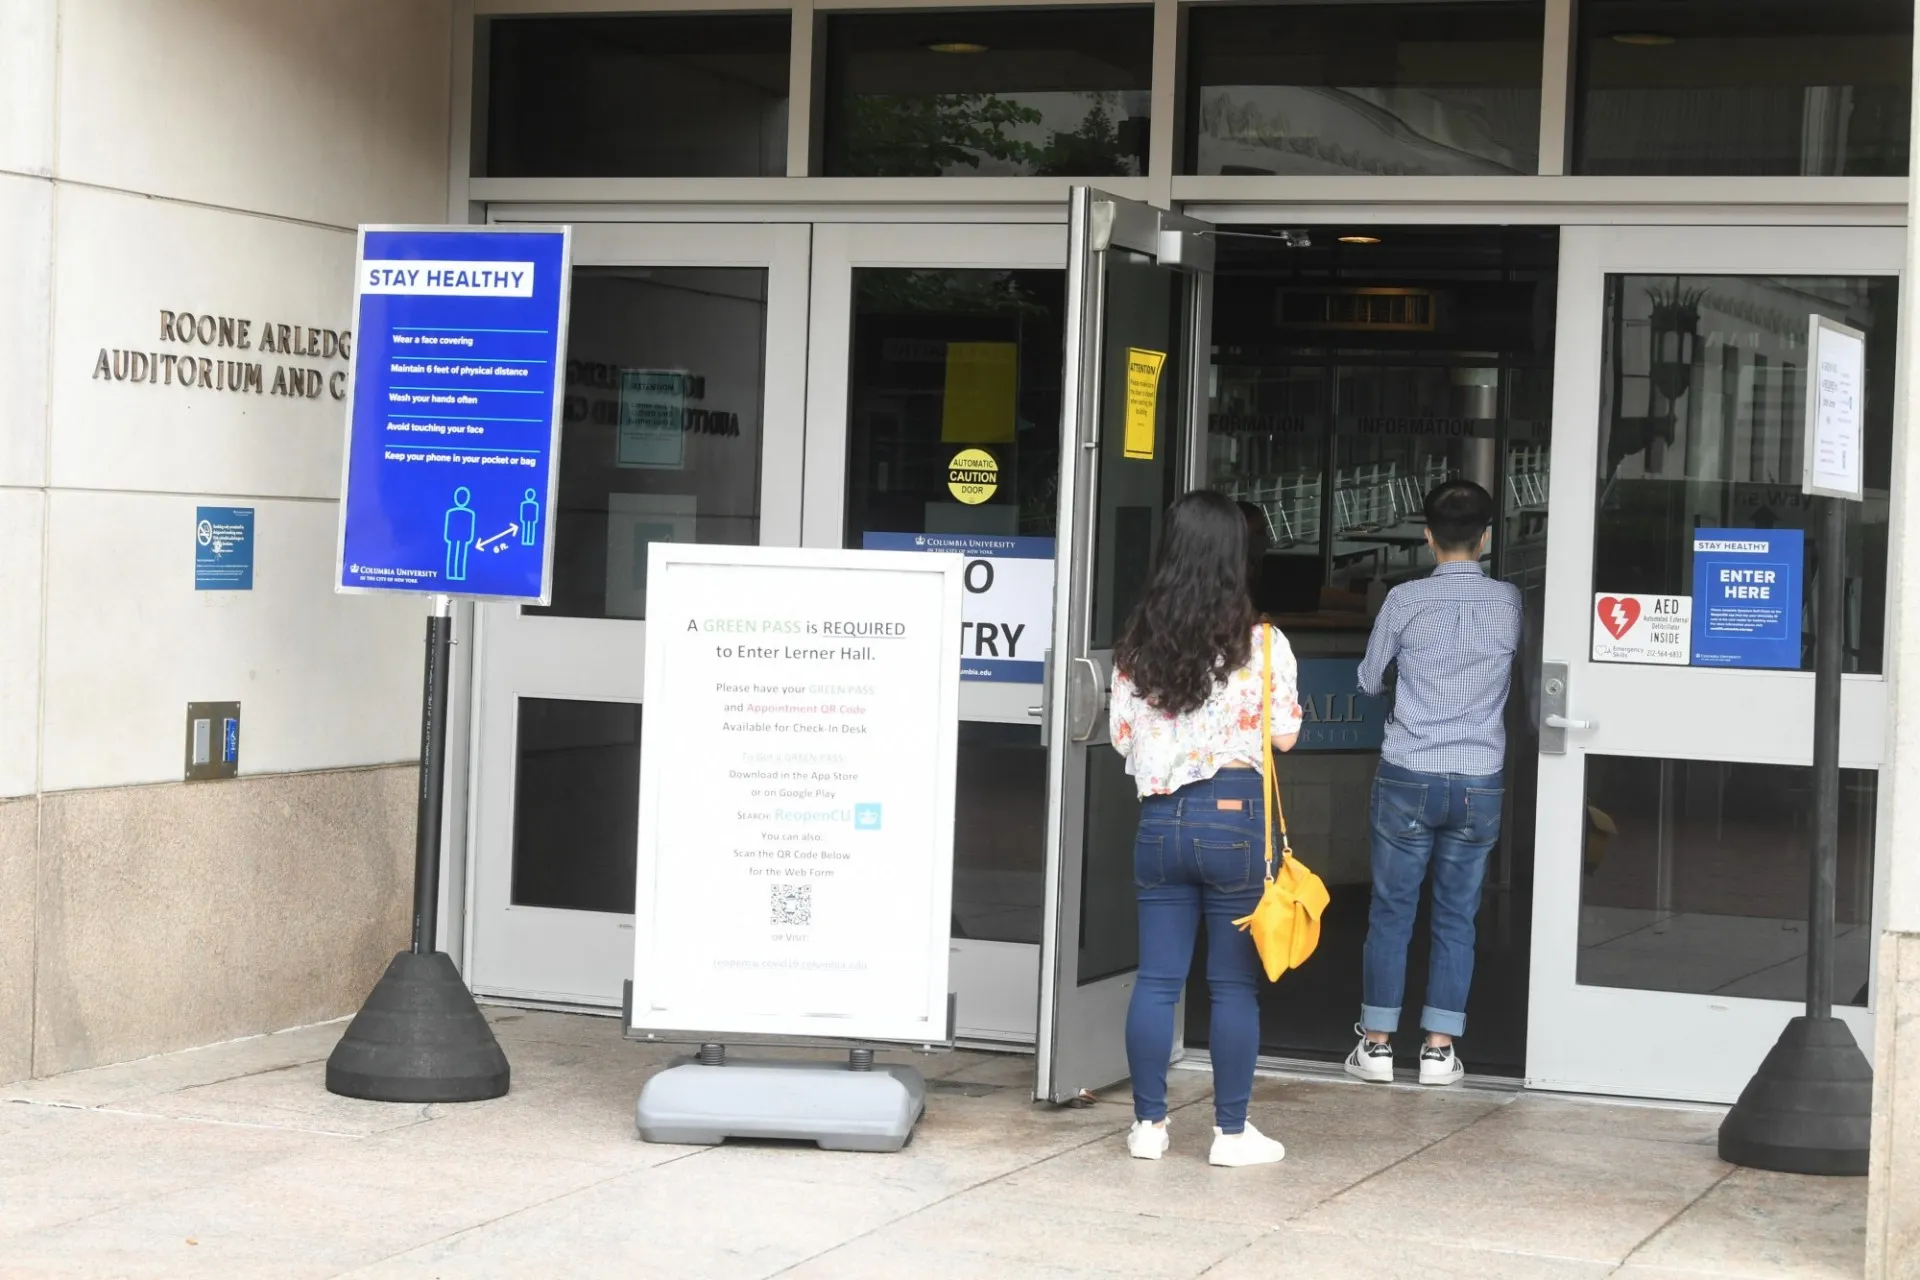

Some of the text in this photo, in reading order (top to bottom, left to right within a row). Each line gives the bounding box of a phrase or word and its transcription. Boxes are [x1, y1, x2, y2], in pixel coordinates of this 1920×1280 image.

[369, 269, 524, 288] STAY HEALTHY
[160, 309, 351, 360] ROONE ARLEDG
[393, 335, 413, 344] Wear
[421, 336, 438, 344] face
[439, 337, 473, 347] covering
[92, 348, 349, 400] AUDITORIUM AND C
[391, 364, 528, 376] Maintain 6 feet of physical distance
[389, 393, 478, 404] Wash your hands often
[387, 422, 484, 434] Avoid touching your face
[1208, 414, 1305, 432] FORMATION
[385, 451, 536, 467] Keep your phone in your pocket or bag
[952, 459, 993, 468] AUTOMATIC
[950, 471, 996, 483] CAUTION
[961, 485, 983, 494] DOOR
[927, 538, 1016, 548] COLUMBIA UNIVERSITY
[493, 545, 500, 554] 6
[360, 566, 438, 578] COLUMBIA UNIVERSITY
[964, 559, 994, 594] O
[1720, 569, 1776, 583] ENTER
[1724, 585, 1770, 599] HERE
[1654, 598, 1679, 614] AED
[686, 618, 906, 637] A GREEN PASS is REQUIRED
[960, 622, 1026, 658] TRY
[1650, 632, 1680, 644] INSIDE
[716, 645, 876, 661] to Enter Lerner Hall.
[1613, 645, 1645, 653] Emergency
[716, 682, 750, 694] Please
[753, 683, 779, 694] have
[781, 685, 806, 696] your
[809, 684, 845, 695] GREEN
[724, 702, 866, 716] and Appointment QR Code
[1303, 693, 1364, 723] ALL
[722, 722, 867, 734] Available for Check-In Desk
[729, 769, 858, 782] Download in the App Store
[763, 789, 777, 797] on
[779, 788, 813, 799] Google
[815, 788, 836, 800] Play
[774, 808, 851, 824] ReopenCU
[761, 831, 780, 841] You
[782, 833, 799, 841] can
[733, 849, 851, 860] Scan the QR Code Below
[749, 867, 834, 877] for the Web Form
